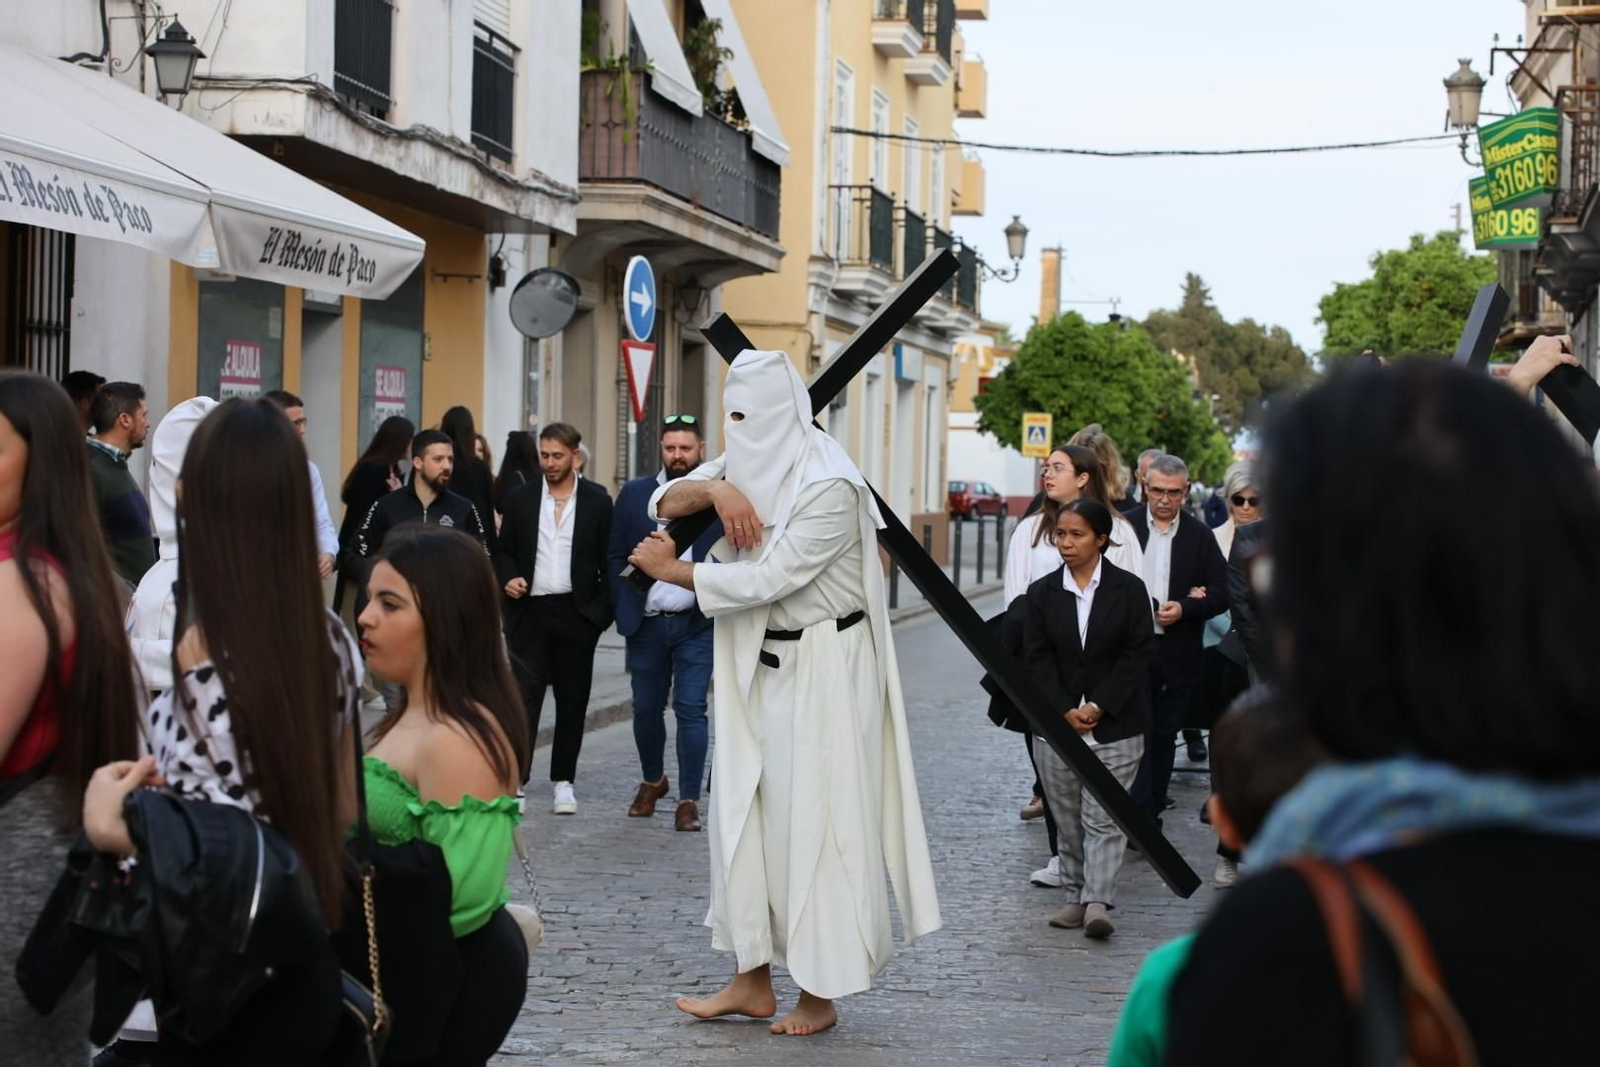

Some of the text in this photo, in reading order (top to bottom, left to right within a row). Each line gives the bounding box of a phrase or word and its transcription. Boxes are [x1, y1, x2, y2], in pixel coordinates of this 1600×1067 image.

[5, 160, 83, 218] Mesón
[83, 181, 110, 223] de
[100, 185, 153, 235] Paco
[259, 226, 377, 286] El Mesón de Paco
